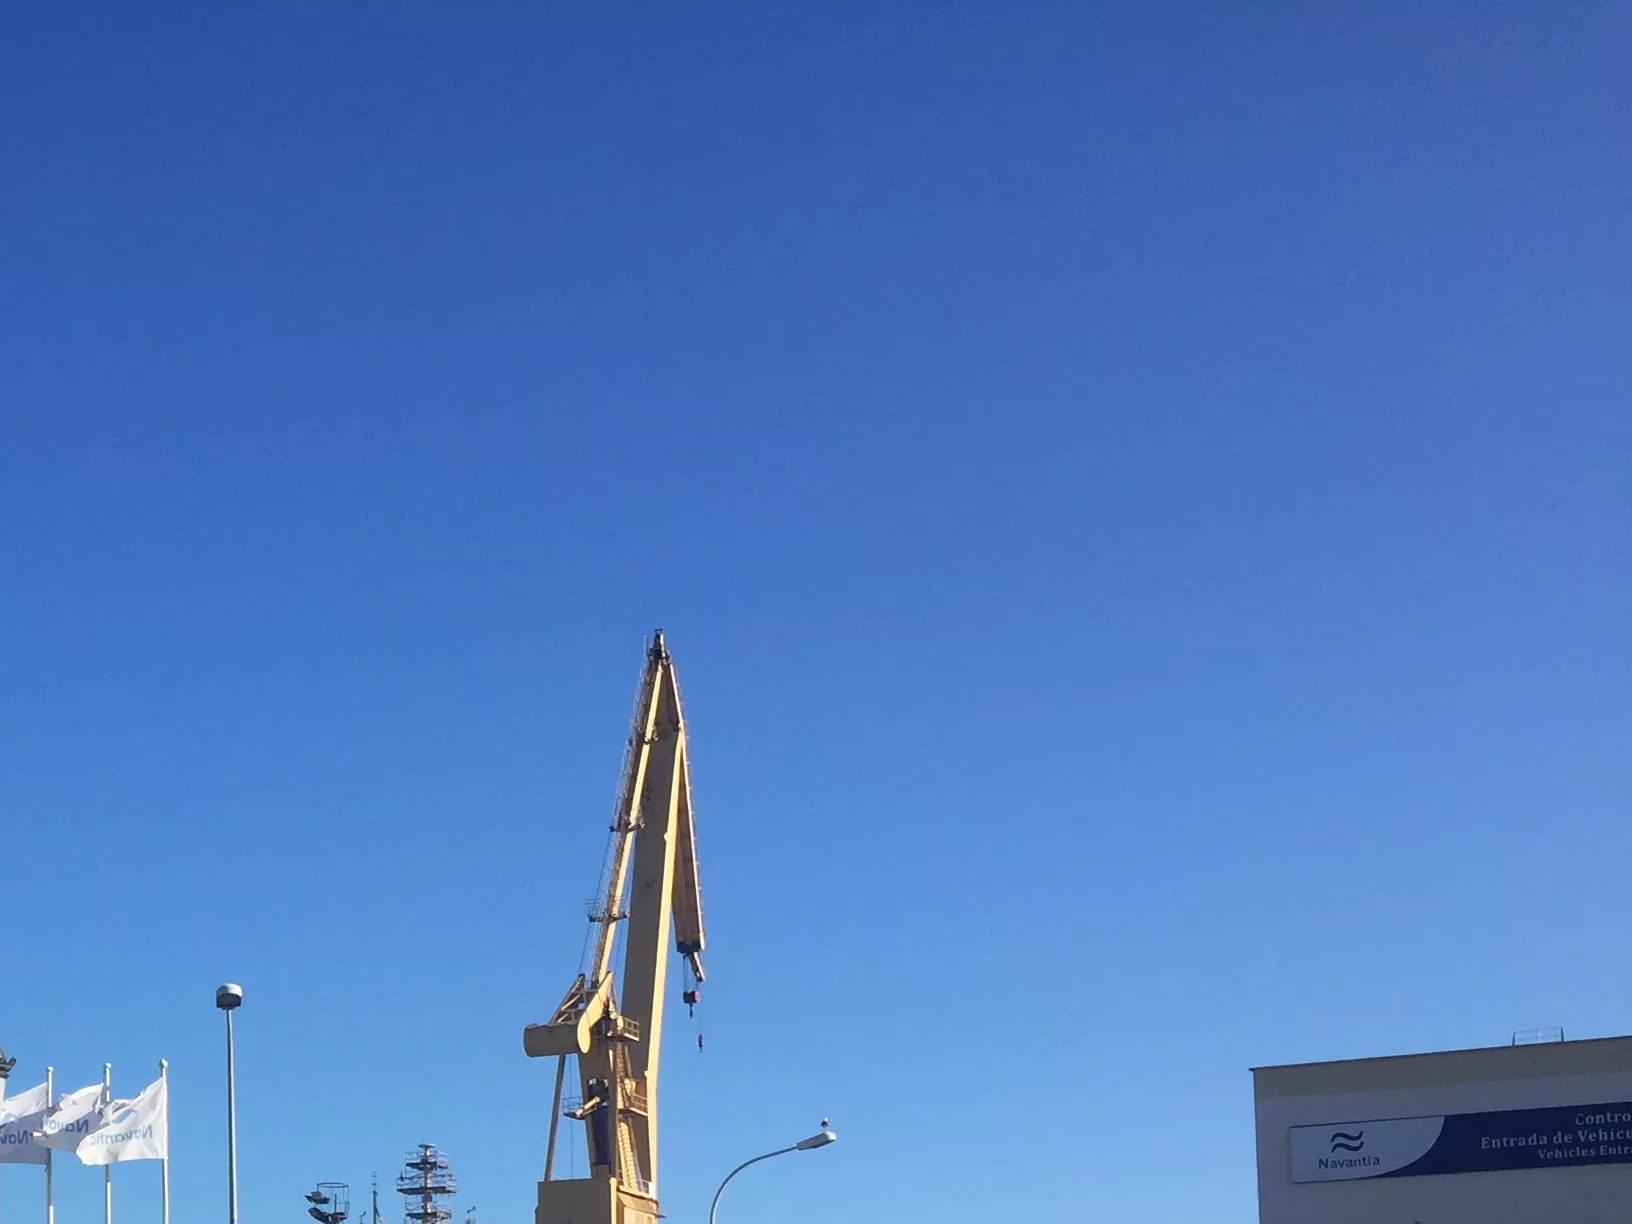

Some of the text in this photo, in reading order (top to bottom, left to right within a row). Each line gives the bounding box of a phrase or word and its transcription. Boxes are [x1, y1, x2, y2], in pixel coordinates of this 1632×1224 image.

[1480, 1132, 1548, 1150] Entrada
[1552, 1130, 1573, 1145] de
[1537, 1143, 1632, 1160] Vehicles Entr
[1318, 1155, 1381, 1170] Navantia
